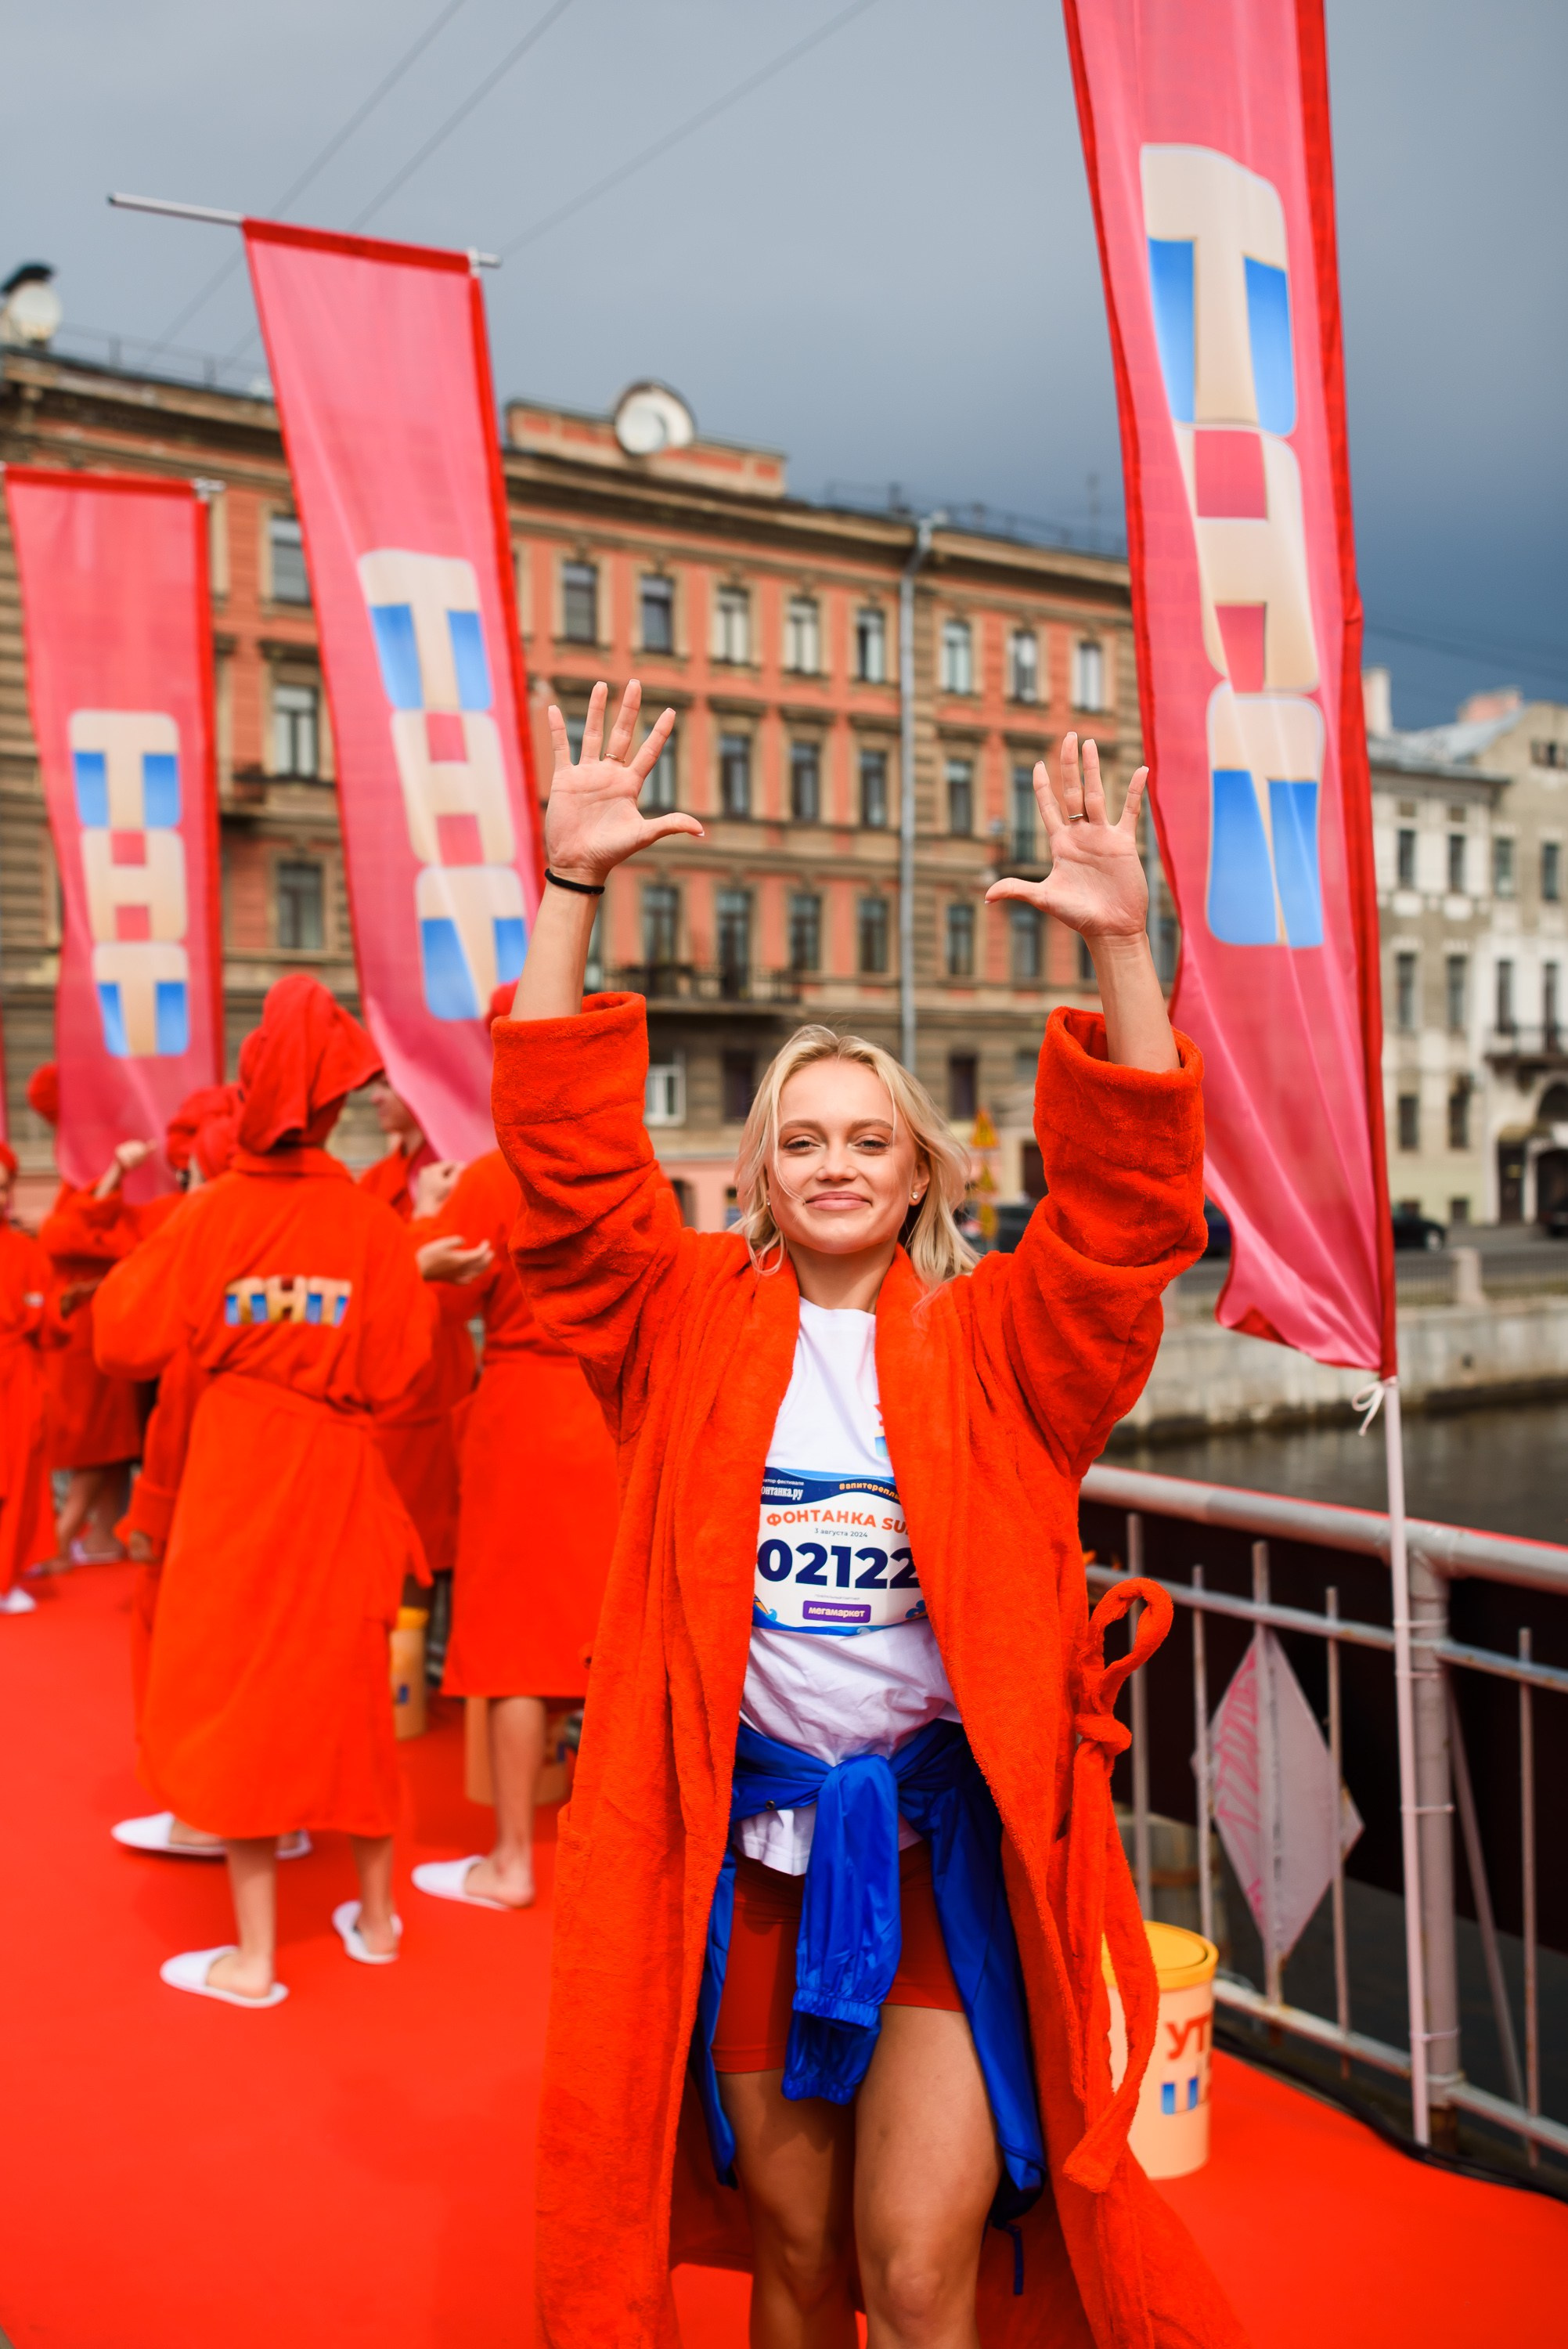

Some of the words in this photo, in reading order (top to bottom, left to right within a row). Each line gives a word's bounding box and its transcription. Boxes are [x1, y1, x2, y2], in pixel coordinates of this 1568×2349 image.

[68, 709, 189, 1057] ТНТ
[224, 1275, 352, 1328] ТНТ
[767, 1510, 876, 1527] ФОНТАНКА
[881, 1517, 910, 1535] SU
[757, 1538, 921, 1589] 02122
[808, 1607, 865, 1618] мегамаркет
